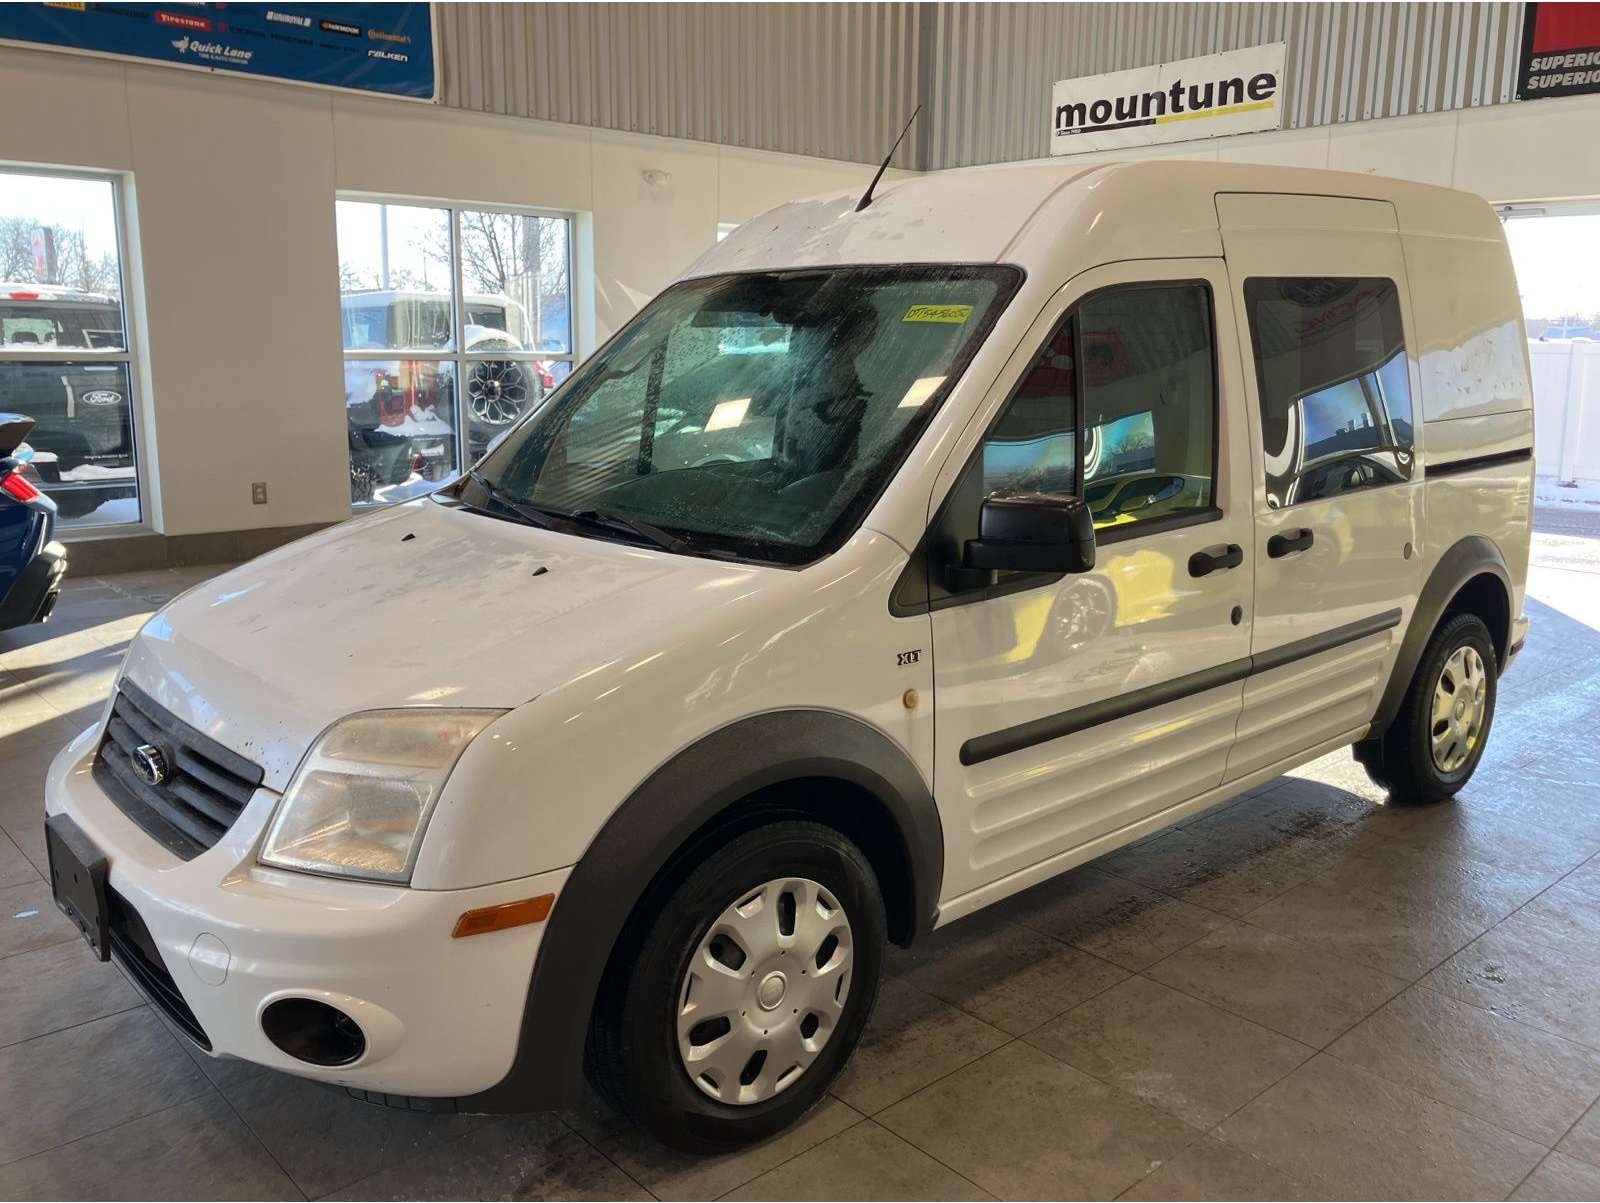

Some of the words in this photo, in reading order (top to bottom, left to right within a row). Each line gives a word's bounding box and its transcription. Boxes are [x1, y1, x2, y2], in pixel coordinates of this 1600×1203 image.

[161, 14, 206, 28] Firestone
[190, 40, 223, 54] Quick
[223, 46, 253, 59] Lane
[367, 50, 408, 62] FALKEN
[1055, 72, 1277, 129] mountune
[897, 649, 922, 666] XLT
